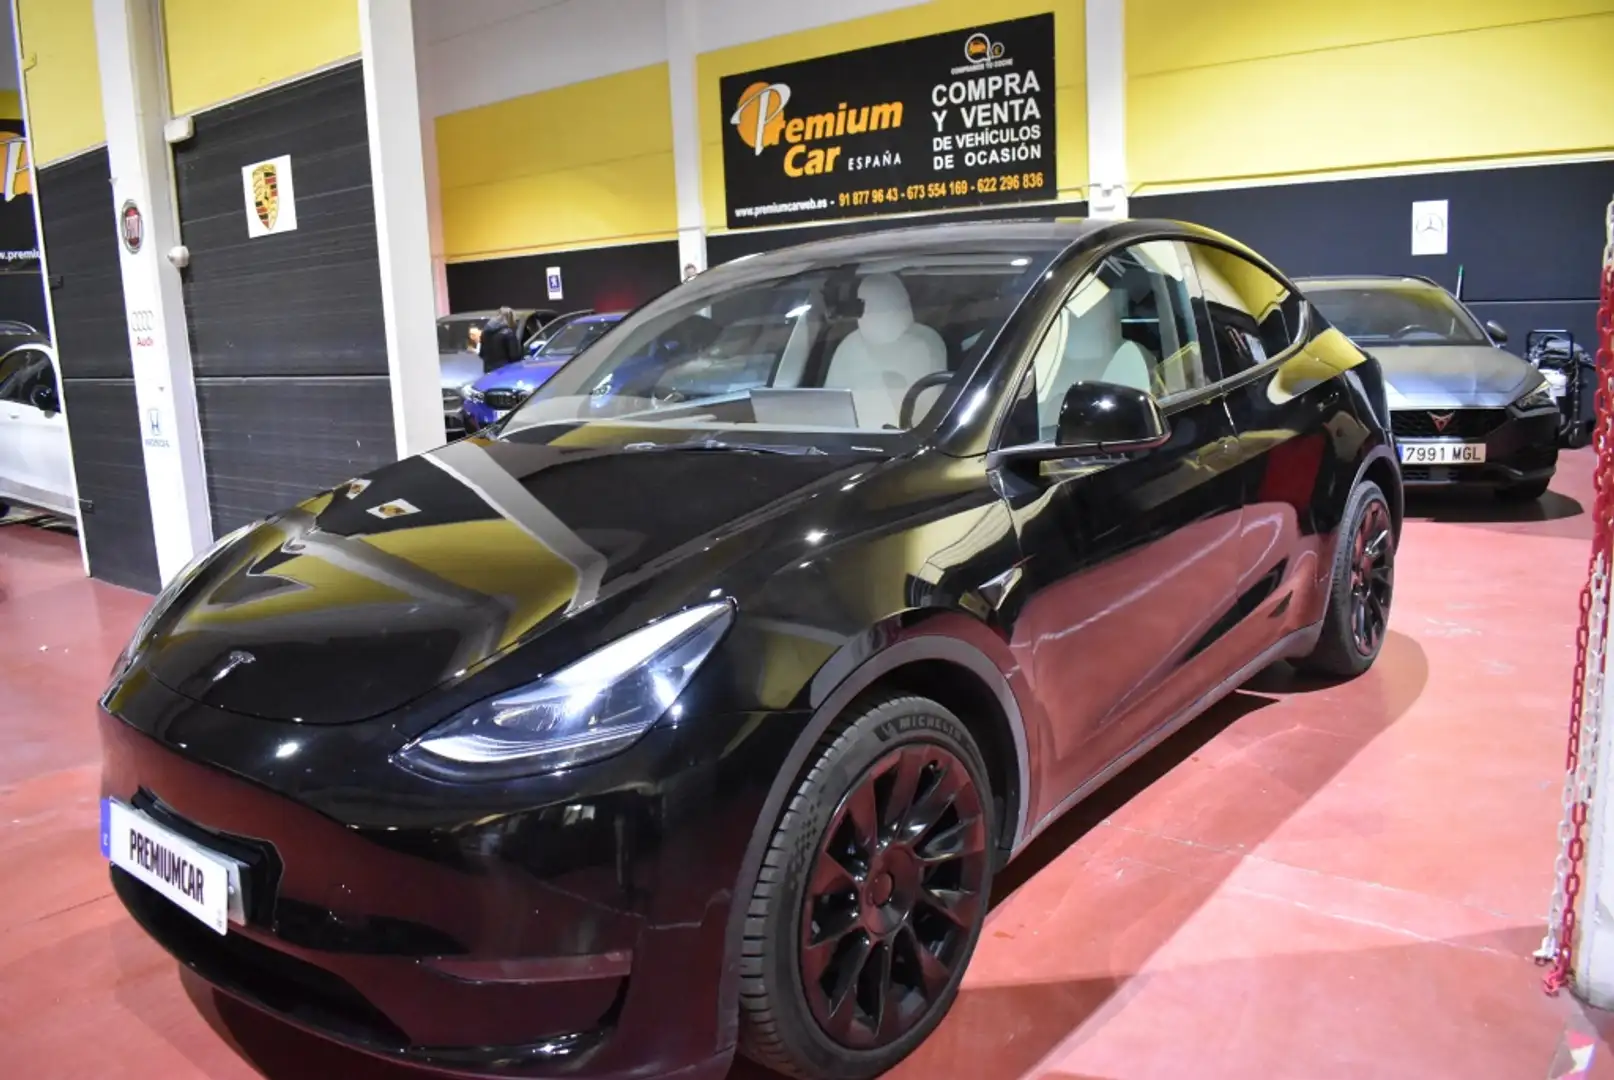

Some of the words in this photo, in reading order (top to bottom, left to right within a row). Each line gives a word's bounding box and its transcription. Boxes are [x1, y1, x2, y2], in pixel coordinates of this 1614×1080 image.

[932, 69, 1041, 107] COMPRA
[730, 82, 904, 156] Premium
[932, 109, 948, 133] Y
[960, 96, 1042, 129] VENTA
[933, 135, 954, 152] DE
[955, 124, 1042, 149] VEHÍCULOS
[933, 154, 955, 171] DE
[964, 141, 1042, 167] OCASIÓN
[783, 144, 841, 178] Car
[847, 150, 902, 171] ESPAÑA
[734, 198, 828, 218] www.premiumcarweb.es
[838, 192, 850, 207] 91
[852, 189, 870, 205] 877
[871, 188, 884, 203] 96
[886, 187, 899, 203] 43
[907, 184, 926, 200] 673
[927, 182, 947, 198] 554
[977, 177, 998, 193] 622
[999, 174, 1020, 191] 296
[1405, 447, 1445, 461] 7991
[1452, 446, 1482, 460] MGL
[129, 828, 205, 905] PREMIUMCAR
